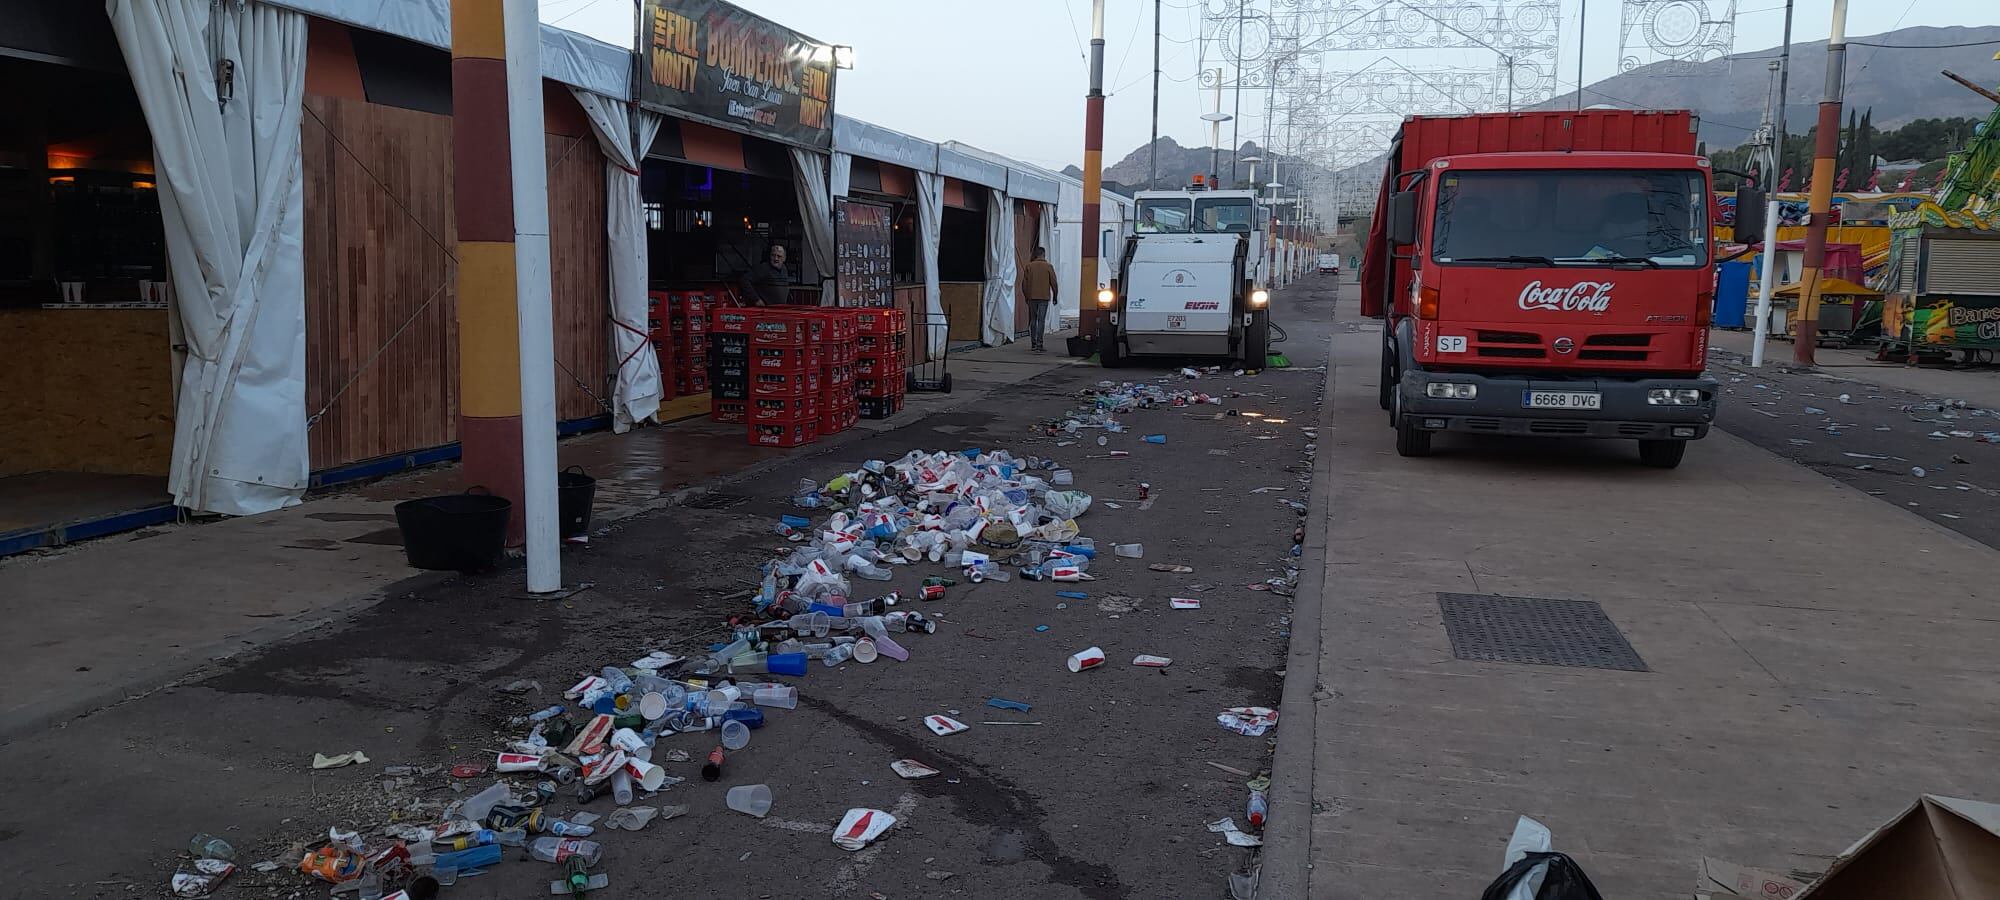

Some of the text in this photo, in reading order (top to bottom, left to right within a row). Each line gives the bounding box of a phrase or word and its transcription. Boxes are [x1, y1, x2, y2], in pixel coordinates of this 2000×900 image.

[653, 6, 666, 46] THE
[665, 11, 698, 58] FULL
[650, 46, 698, 94] MONTY
[808, 66, 828, 101] FULL
[799, 95, 828, 129] MONTY
[1184, 301, 1219, 310] ELGIN
[1518, 280, 1616, 313] Coca-Cola
[1535, 393, 1596, 407] 6668 DVG
